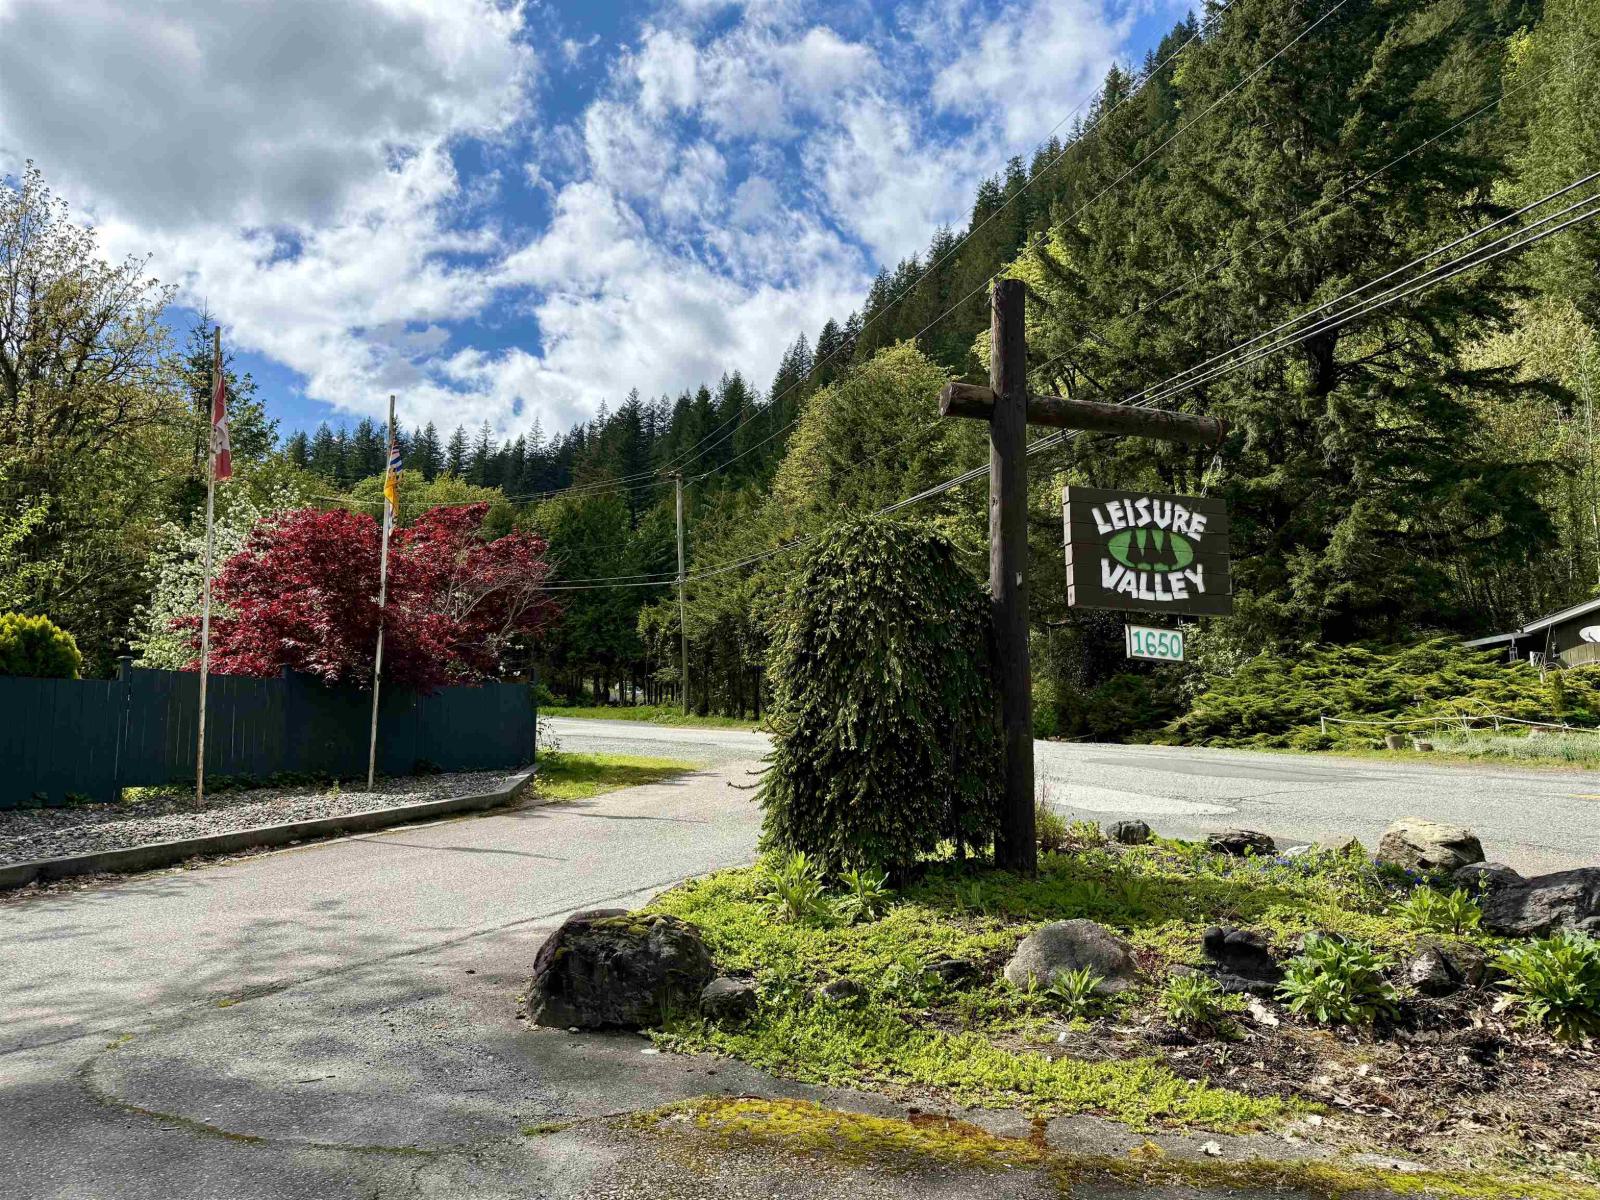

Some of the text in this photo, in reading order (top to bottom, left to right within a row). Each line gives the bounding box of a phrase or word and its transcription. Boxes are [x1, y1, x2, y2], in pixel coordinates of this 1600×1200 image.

[1091, 497, 1207, 542] LEISURE
[1101, 558, 1206, 601] VALLEY
[1132, 630, 1182, 658] 1650
